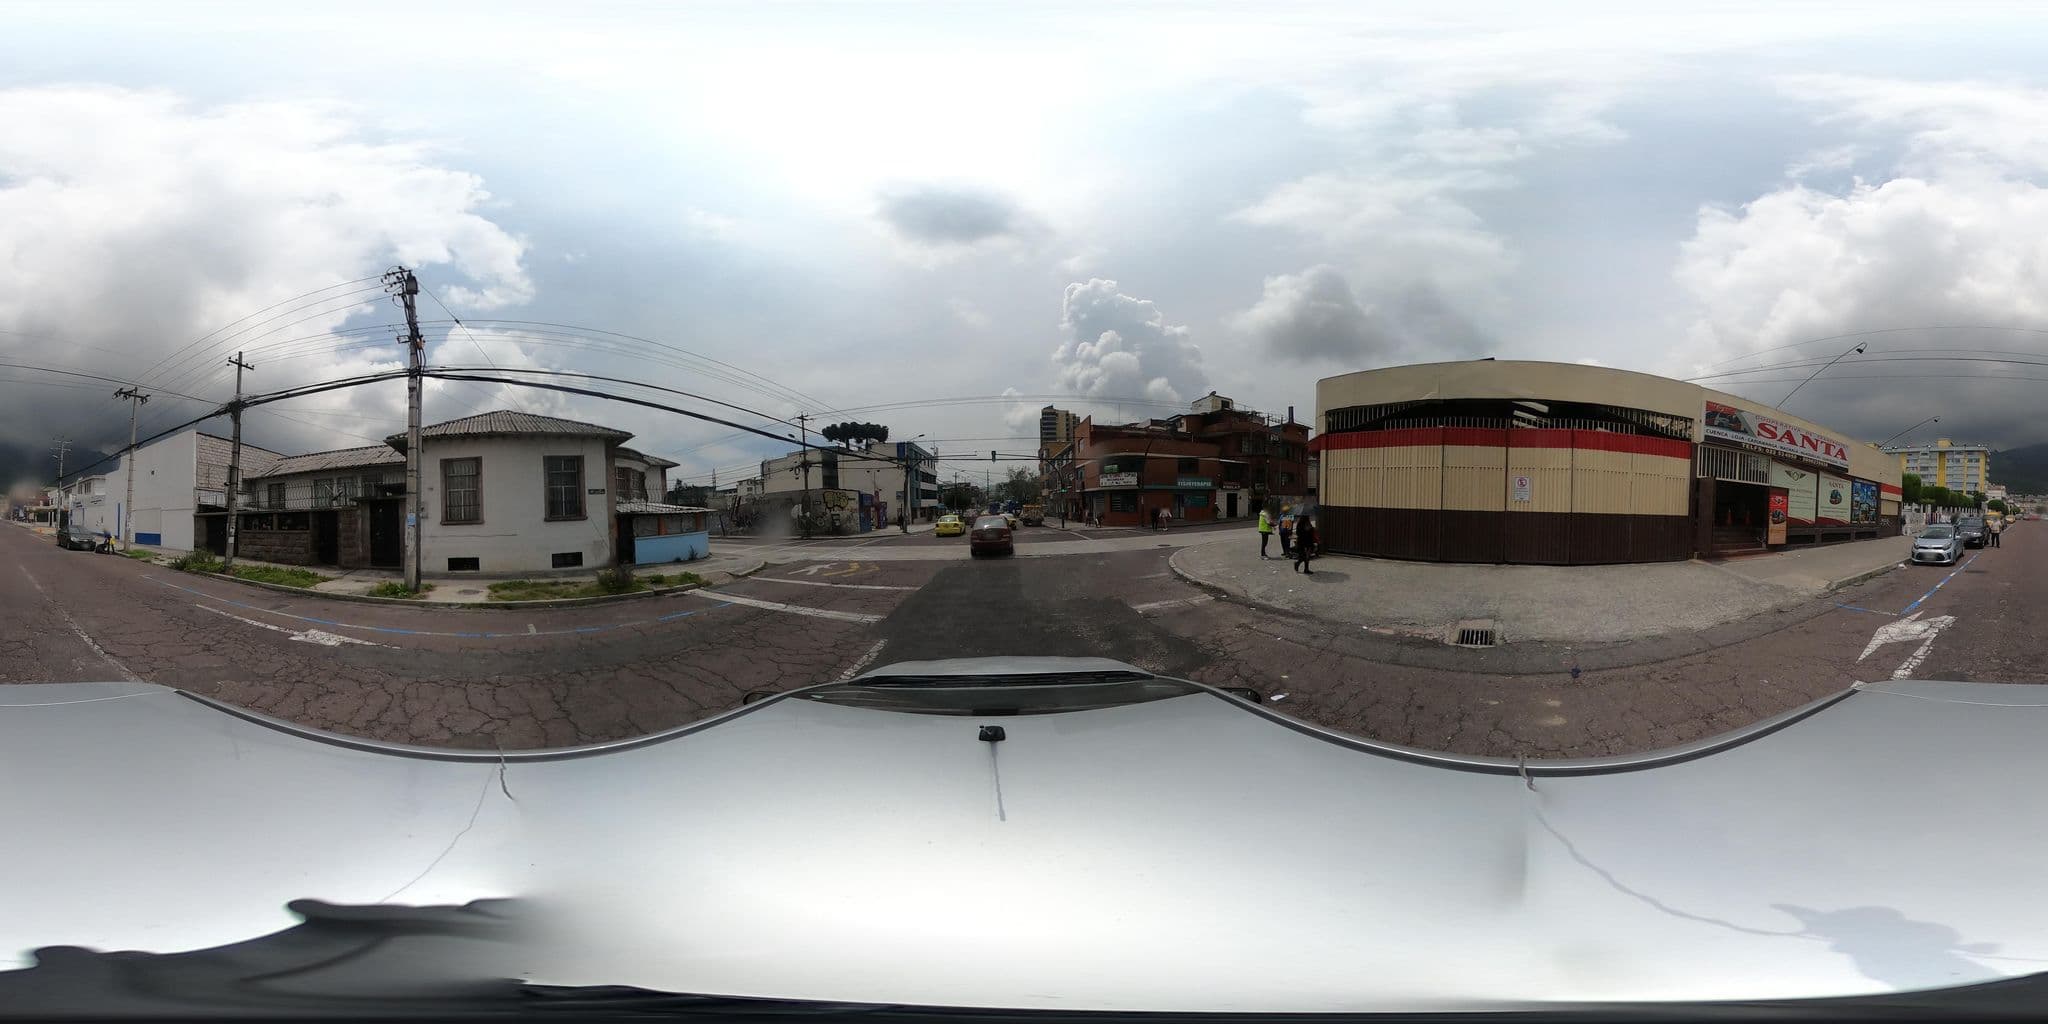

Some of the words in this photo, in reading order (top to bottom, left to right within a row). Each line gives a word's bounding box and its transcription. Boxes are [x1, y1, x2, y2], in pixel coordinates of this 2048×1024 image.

[1705, 428, 1729, 438] CUENCA
[1731, 433, 1745, 442] LOJA
[1757, 422, 1848, 461] SANTA
